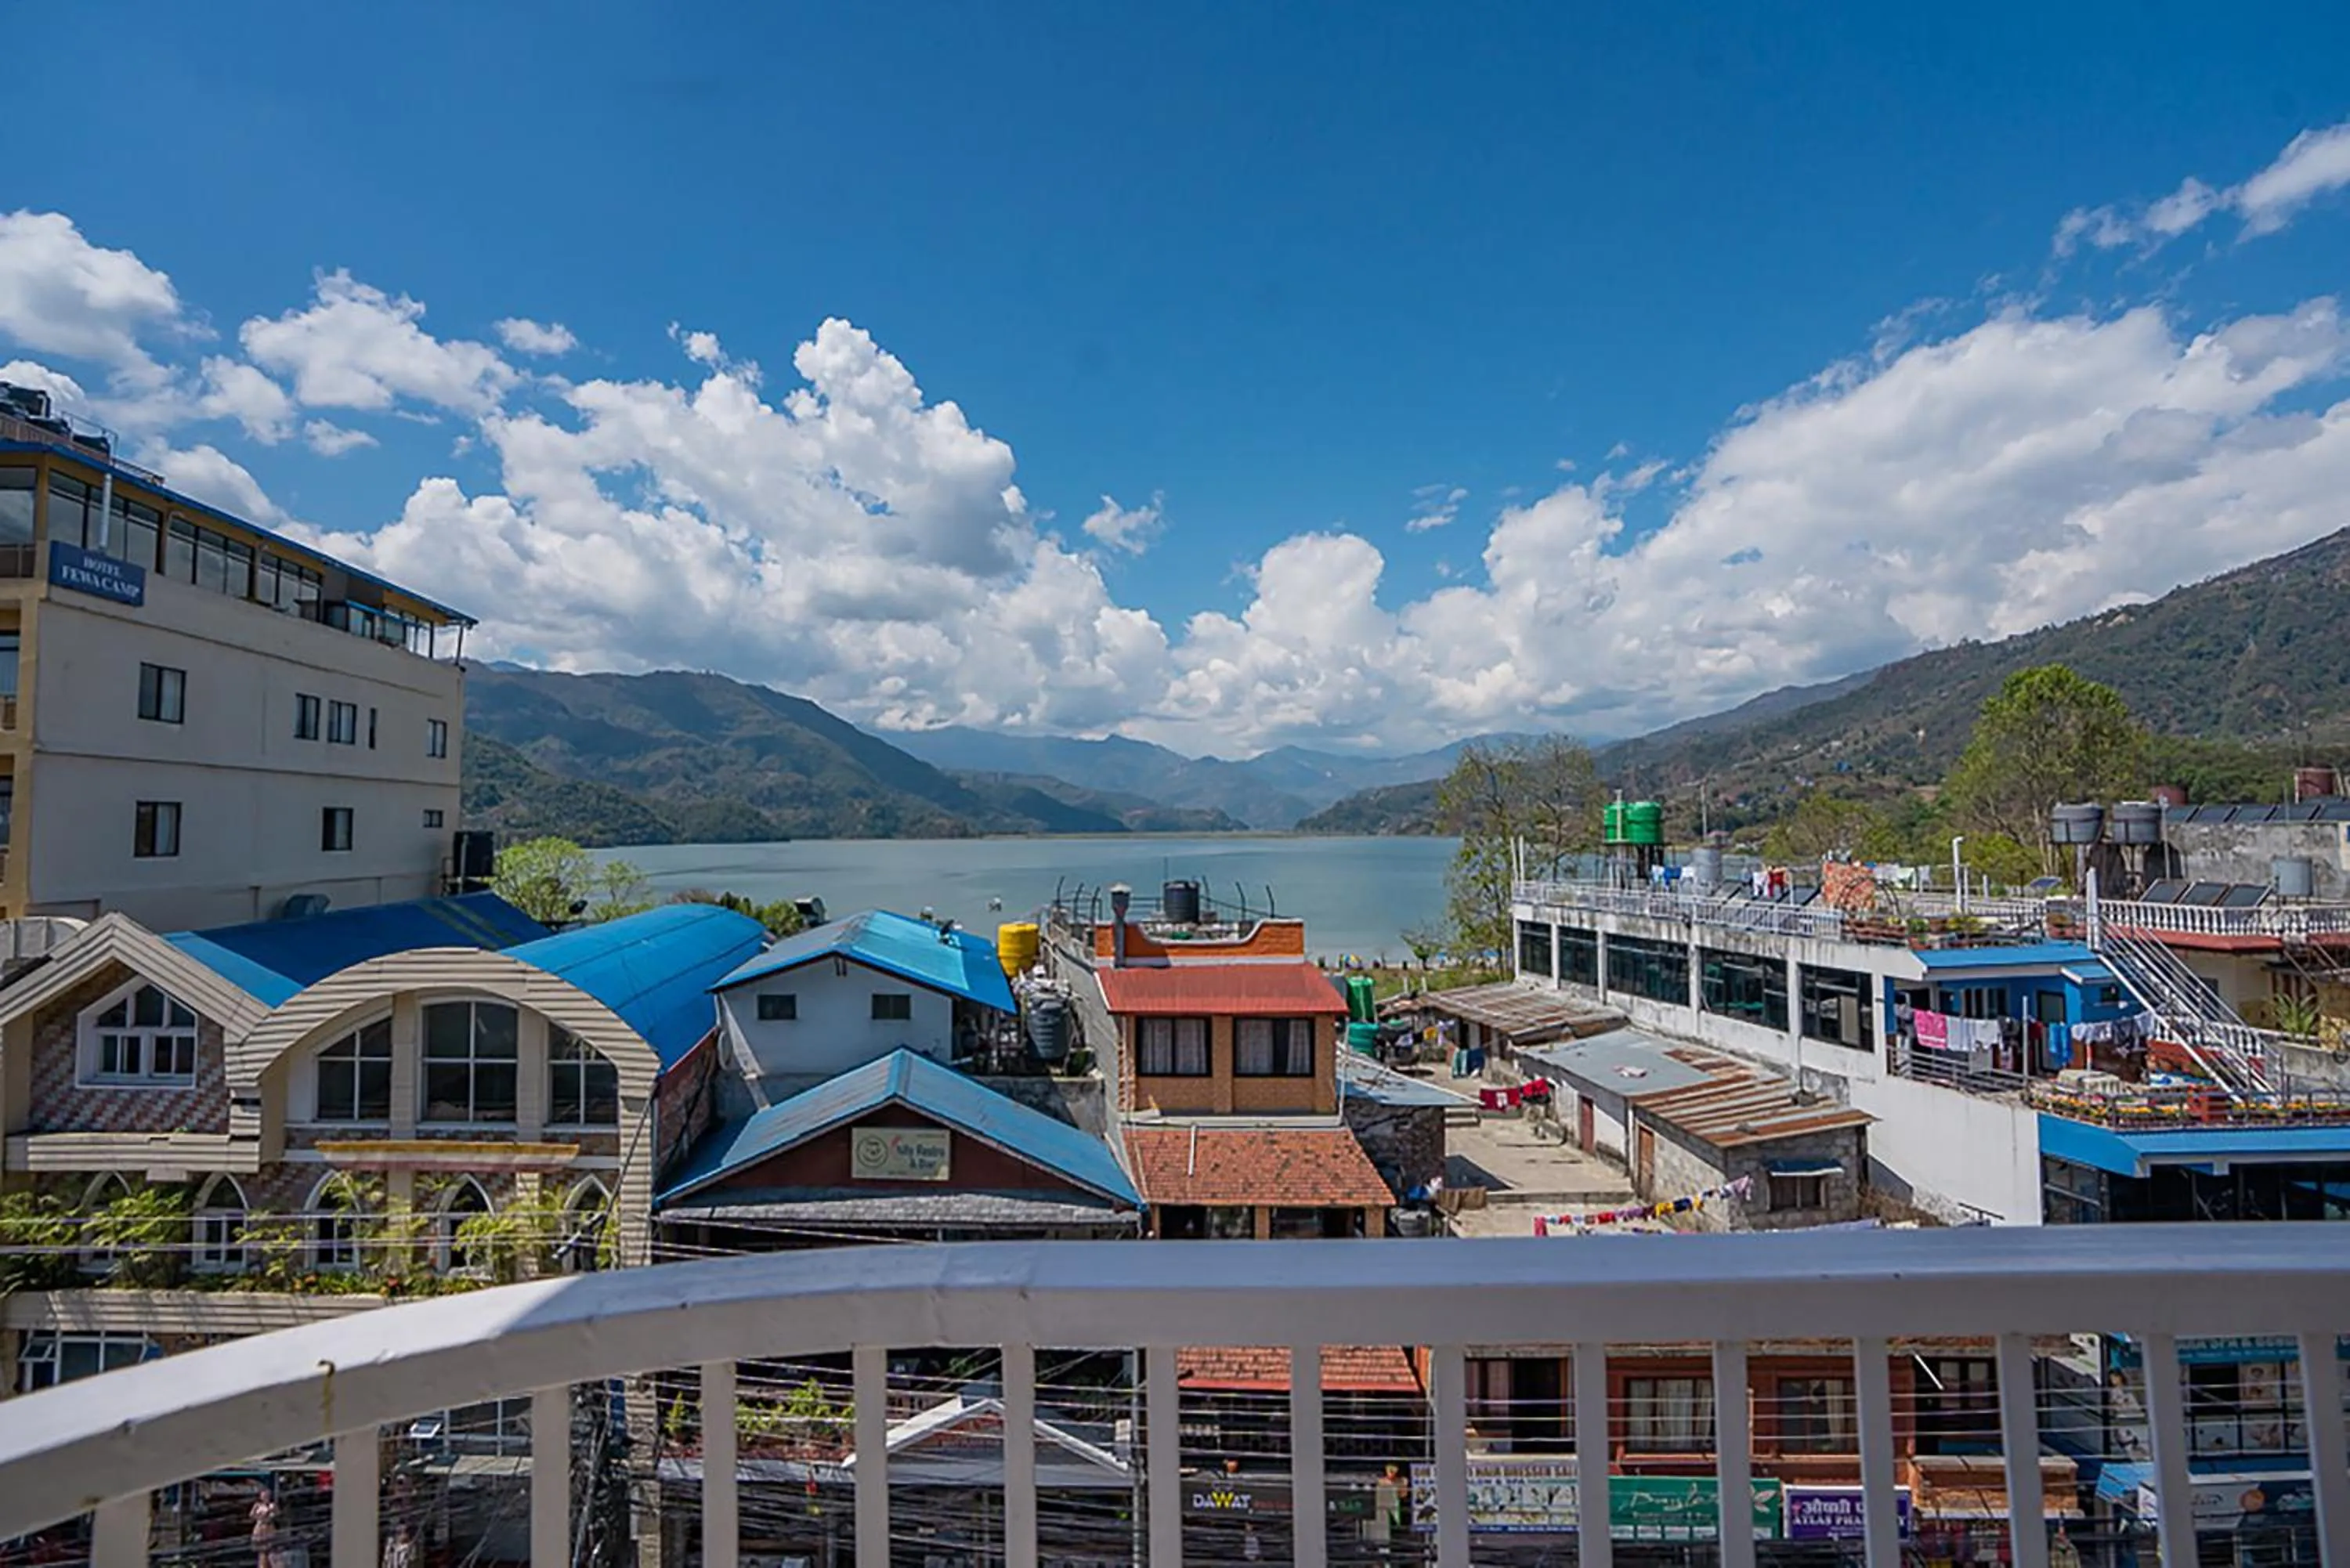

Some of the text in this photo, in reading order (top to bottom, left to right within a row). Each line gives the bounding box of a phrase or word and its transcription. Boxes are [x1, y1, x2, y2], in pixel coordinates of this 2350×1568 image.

[83, 556, 121, 578] HOTEL
[1192, 1491, 1252, 1508] DAWAT
[1792, 1516, 1832, 1526] ATLAS
